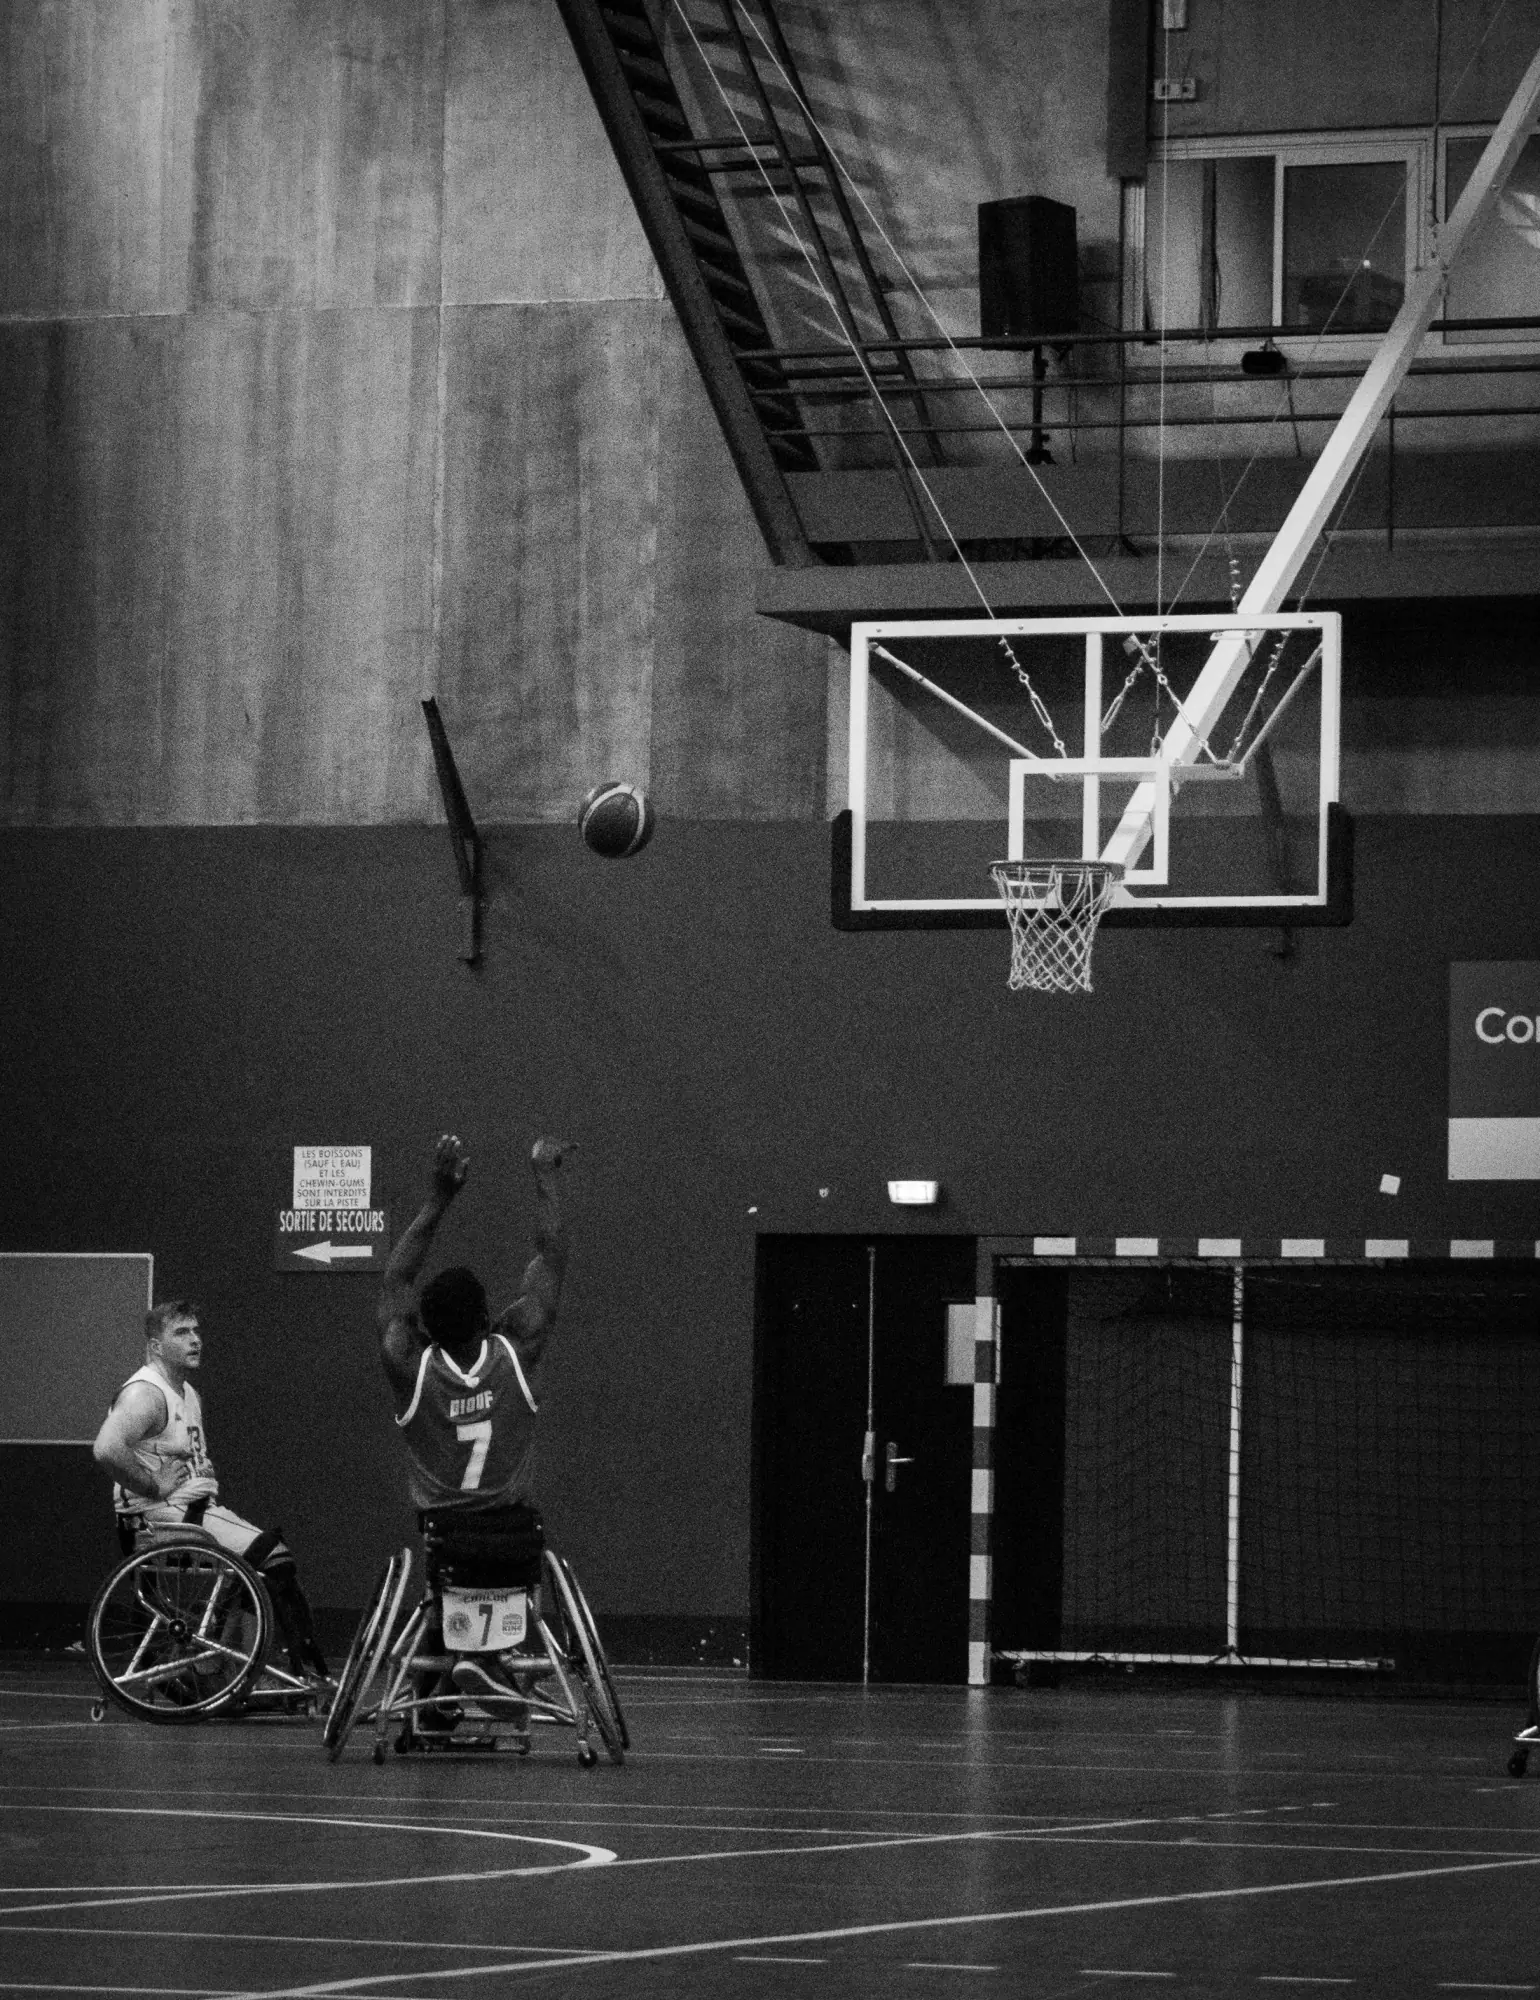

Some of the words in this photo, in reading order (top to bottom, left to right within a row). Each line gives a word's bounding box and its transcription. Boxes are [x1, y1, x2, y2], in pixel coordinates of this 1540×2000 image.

[1475, 1006, 1540, 1044] Co
[302, 1149, 316, 1158] LES
[318, 1149, 363, 1158] BOISSONS
[319, 1169, 328, 1178] ET
[331, 1169, 345, 1178] LES
[297, 1189, 320, 1198] SONT
[324, 1188, 367, 1197] INTERDITS
[304, 1198, 321, 1207] SUR
[324, 1198, 335, 1207] LA
[337, 1198, 359, 1207] PISTE
[279, 1210, 316, 1232] SORTIE
[319, 1210, 333, 1232] DE
[336, 1210, 385, 1232] SECOURS
[456, 1419, 493, 1490] 7
[478, 1603, 493, 1646] 7
